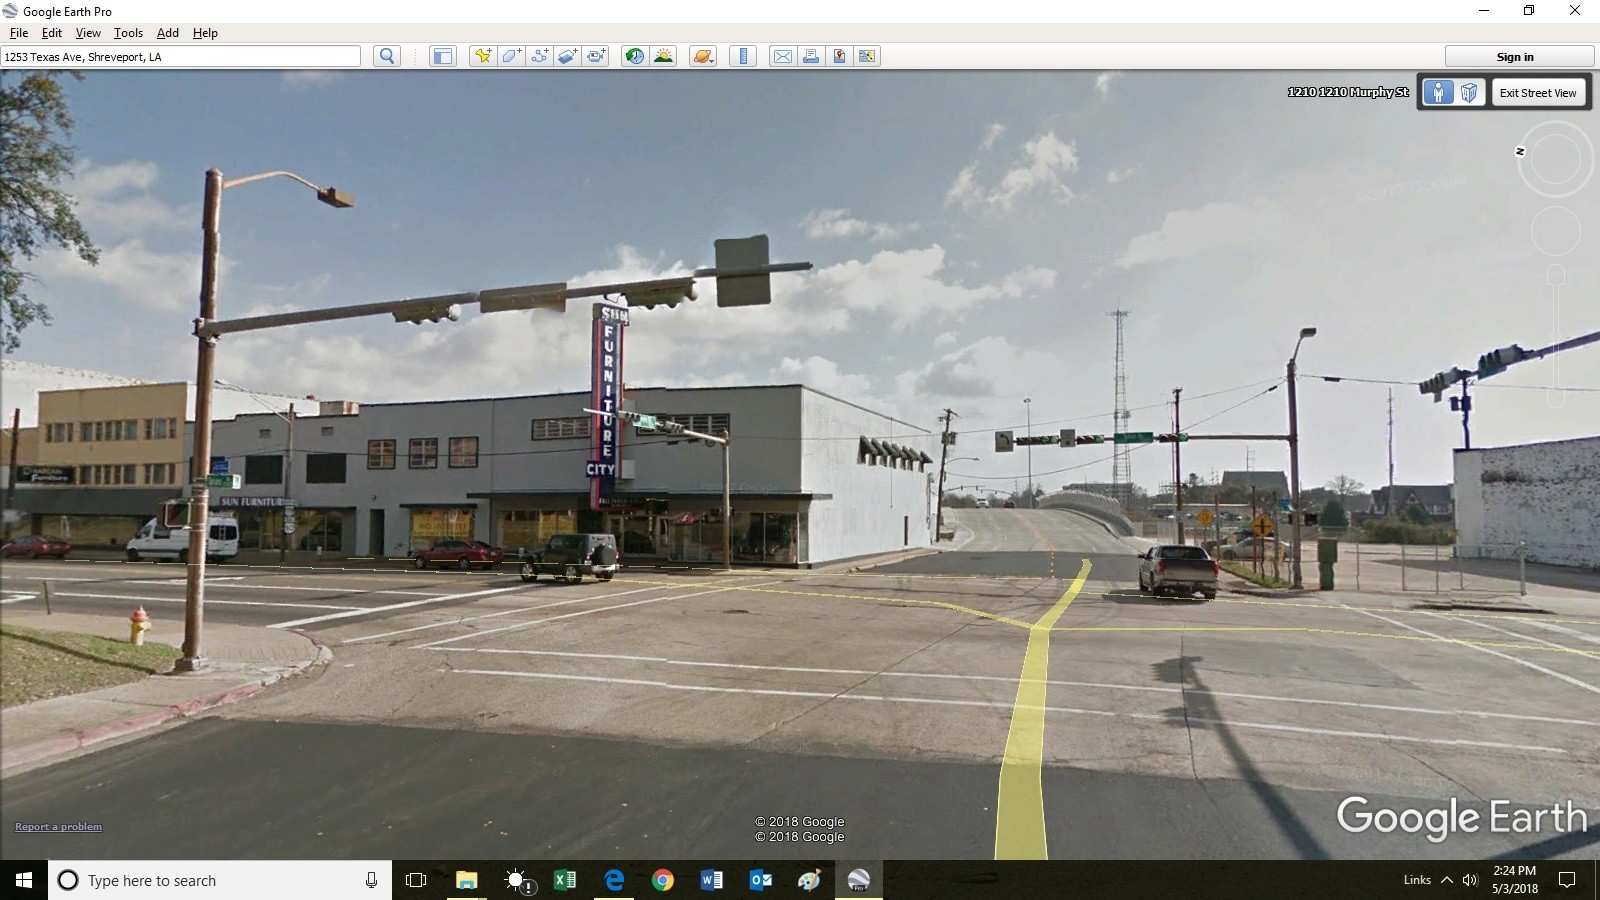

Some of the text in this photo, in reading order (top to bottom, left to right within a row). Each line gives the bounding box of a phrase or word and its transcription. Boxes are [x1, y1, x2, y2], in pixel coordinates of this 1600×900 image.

[23, 7, 112, 20] Google Earth Pro
[9, 27, 29, 40] File
[41, 27, 63, 40] Edit
[76, 27, 102, 40] View
[113, 27, 144, 40] Tools
[157, 27, 179, 40] Add
[193, 27, 218, 41] Help
[5, 52, 162, 64] 1253 Texas Ave, Shreveport, LA
[1496, 52, 1534, 64] Sign in
[1288, 86, 1410, 99] 1210 1210 Murphy St
[1500, 87, 1578, 99] Exit Street View
[601, 306, 629, 322] SUN
[603, 325, 614, 457] FURNITURE
[586, 463, 615, 476] CITY
[221, 498, 239, 506] SUN
[1493, 865, 1537, 876] 2:24 PM
[87, 874, 216, 890] Type here to search
[1403, 874, 1432, 885] Links
[1492, 883, 1539, 895] 5/3/2018
